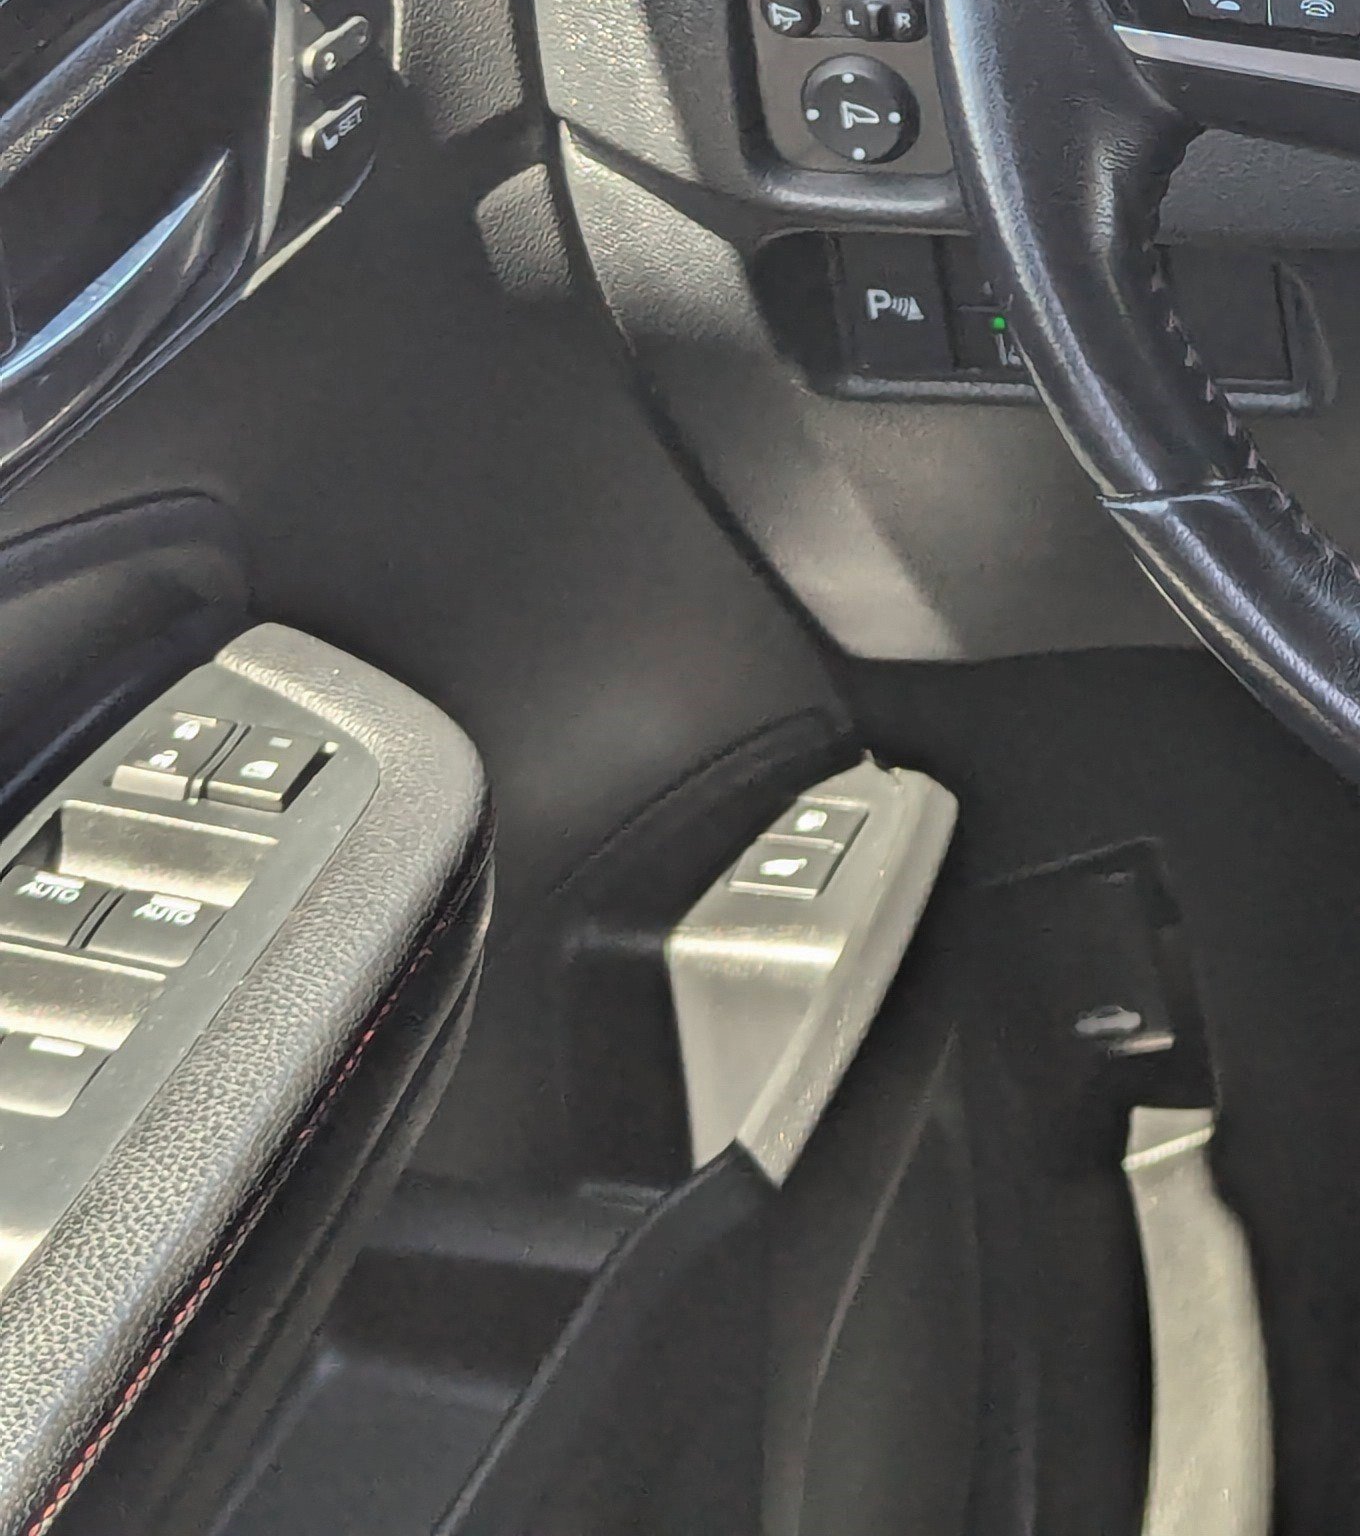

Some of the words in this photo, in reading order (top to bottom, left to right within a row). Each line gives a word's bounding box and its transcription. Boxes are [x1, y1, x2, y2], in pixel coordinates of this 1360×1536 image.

[846, 9, 860, 26] L
[894, 12, 911, 29] R
[323, 52, 336, 71] 2
[15, 881, 82, 904] AUTO
[133, 903, 196, 927] AUTO
